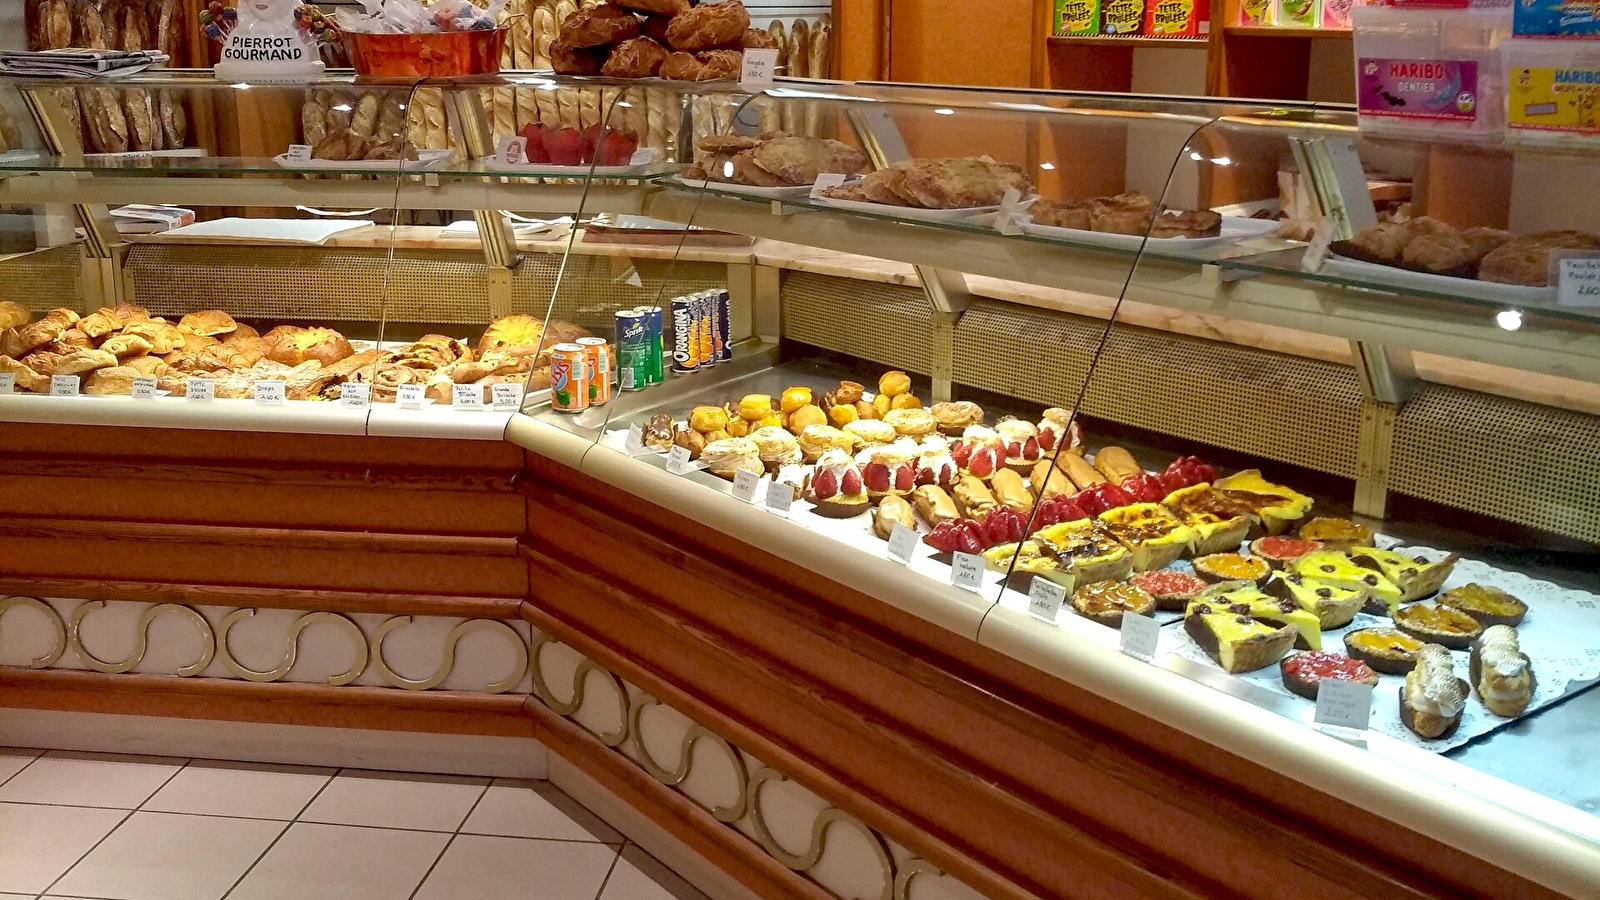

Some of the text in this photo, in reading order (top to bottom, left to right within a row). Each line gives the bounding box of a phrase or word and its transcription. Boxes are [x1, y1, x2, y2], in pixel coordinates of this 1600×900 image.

[232, 36, 293, 49] PIERROT
[225, 48, 302, 61] GOURMAND
[1389, 62, 1446, 80] HARIBO
[1398, 81, 1436, 93] DENTIER
[673, 308, 690, 362] ORANGINA
[956, 554, 969, 562] Flan
